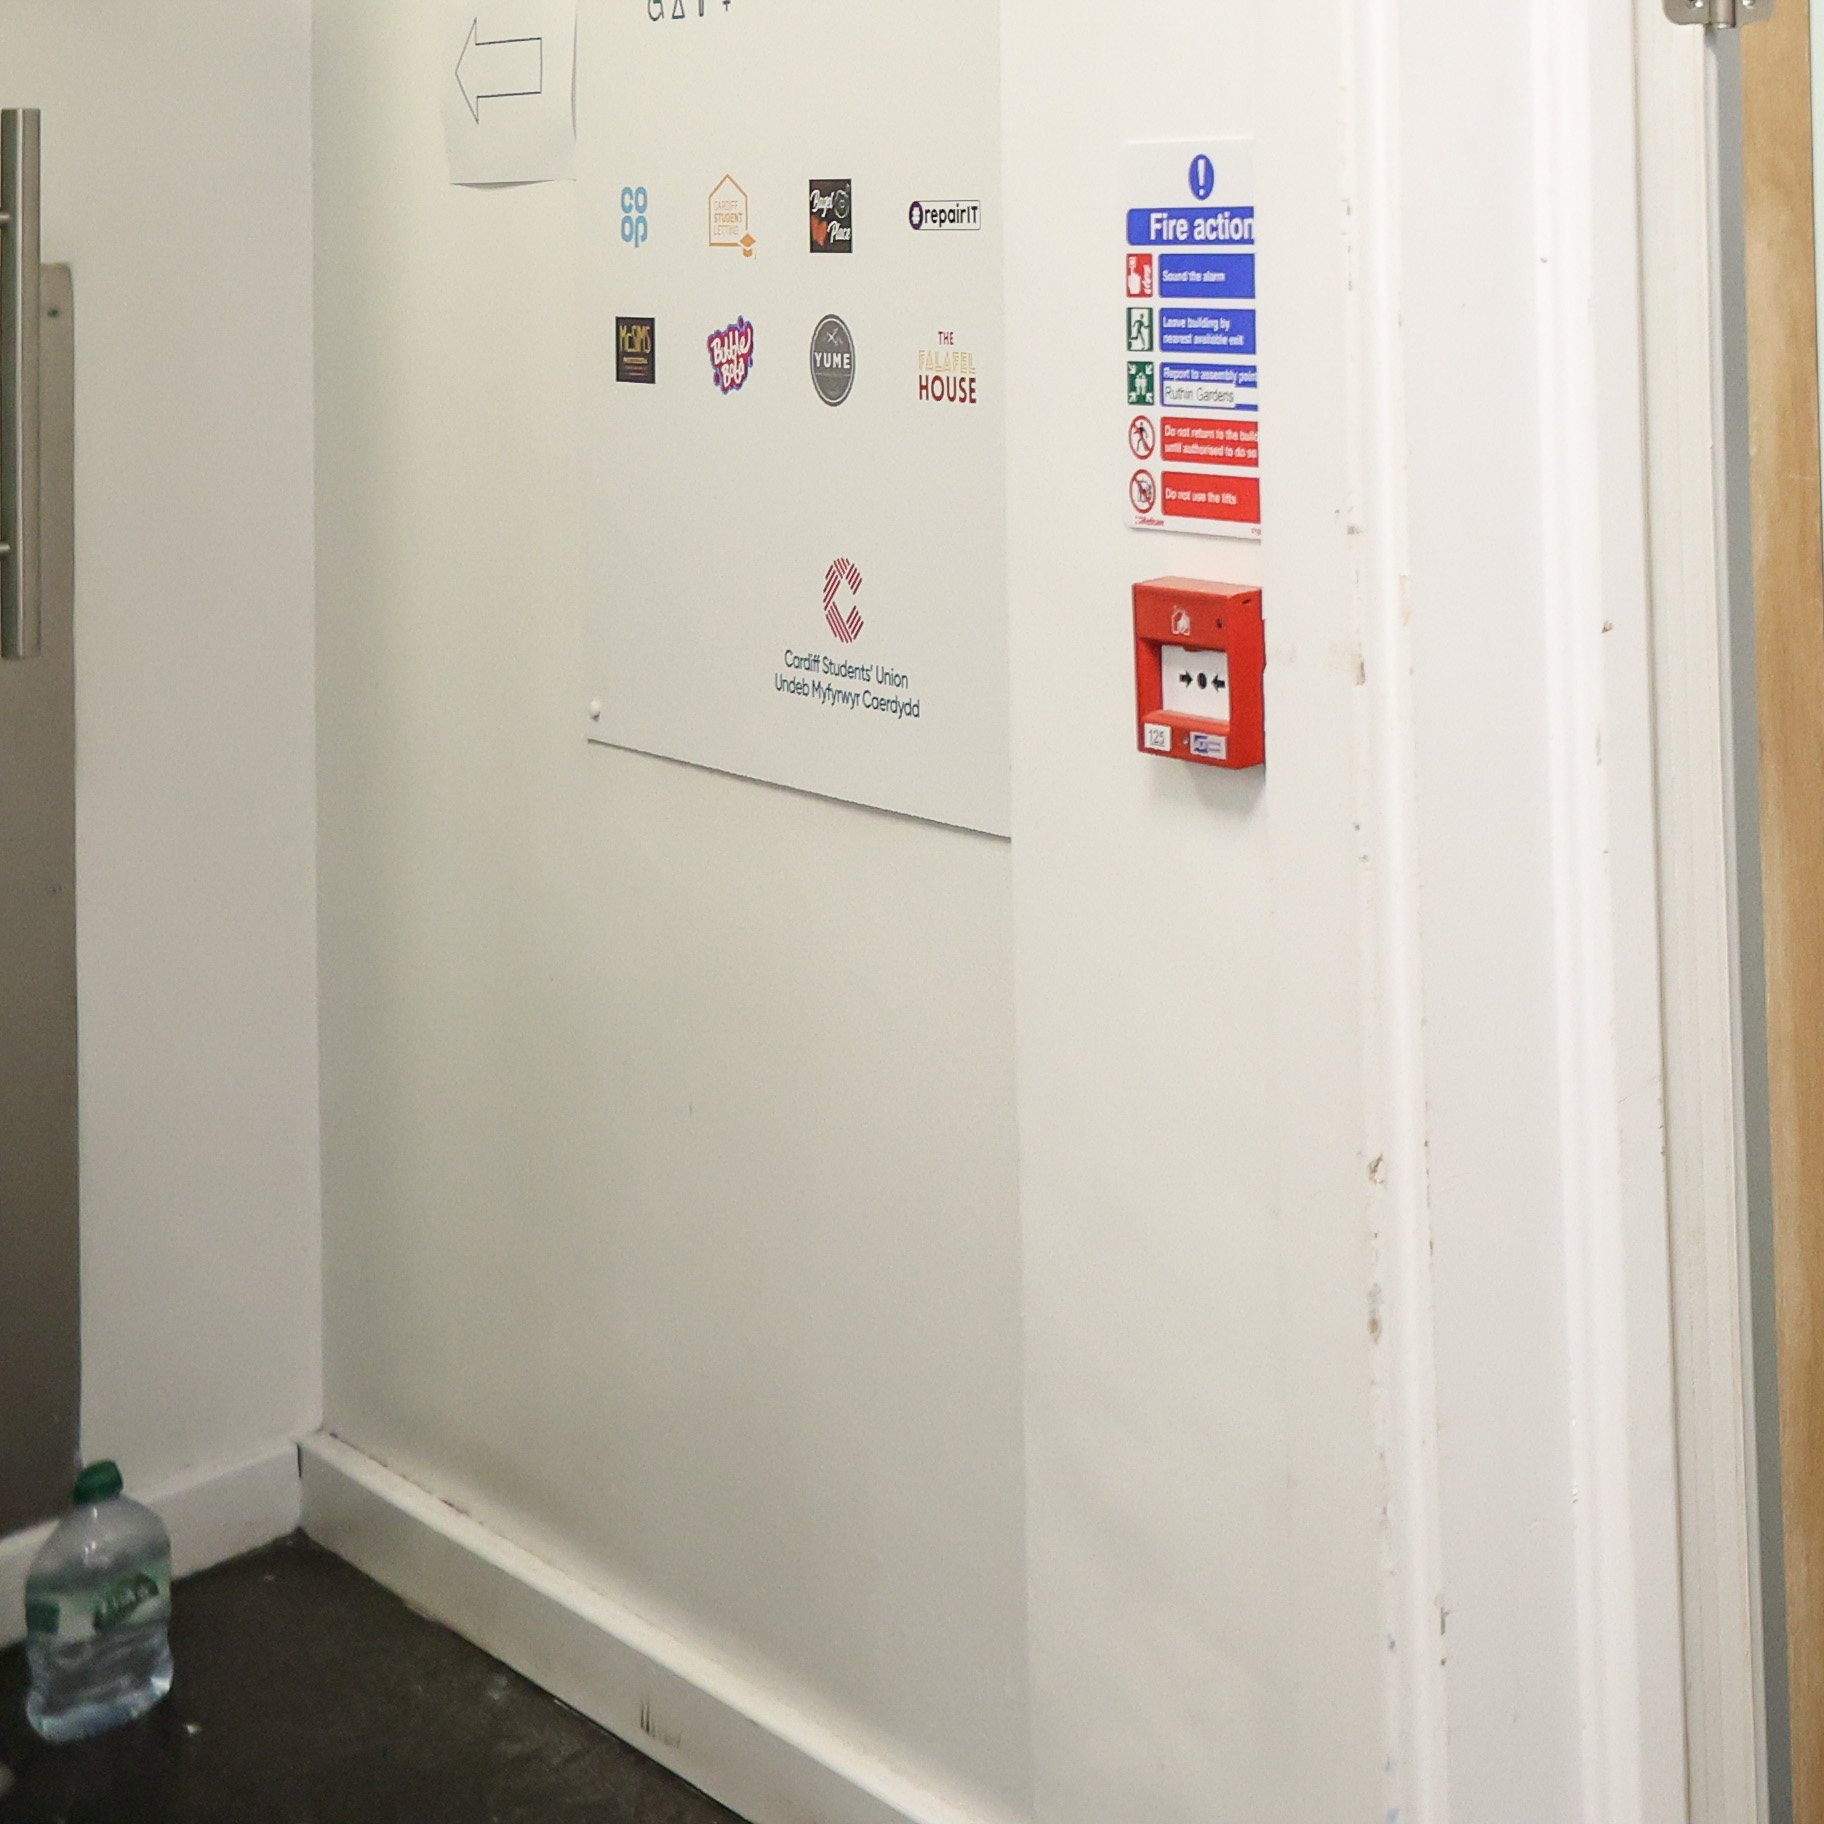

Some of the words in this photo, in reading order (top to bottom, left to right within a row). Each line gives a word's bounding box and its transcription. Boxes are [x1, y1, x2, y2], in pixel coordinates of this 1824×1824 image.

[924, 203, 978, 228] repairIT
[827, 220, 851, 244] Place
[1149, 212, 1190, 241] Fire
[1193, 211, 1254, 241] action
[1162, 270, 1188, 282] Sound
[1188, 271, 1202, 282] the
[1202, 271, 1226, 283] alarm
[1162, 316, 1187, 328] Leave
[1187, 317, 1219, 332] building
[1219, 317, 1231, 332] by
[710, 327, 751, 366] Bubble
[937, 331, 955, 346] THE
[1162, 334, 1193, 344] nearest
[1193, 334, 1228, 345] available
[1228, 335, 1244, 346] exit
[814, 352, 851, 369] YUME
[918, 349, 977, 374] FALAFEL
[721, 357, 746, 388] Boba
[1162, 366, 1190, 381] Report
[1190, 369, 1200, 380] to
[1200, 369, 1237, 385] assembly
[919, 374, 977, 405] HOUSE
[1165, 386, 1193, 401] Ruthin
[1196, 387, 1235, 403] Gardens
[1164, 424, 1176, 437] Do
[1176, 427, 1190, 437] not
[1190, 428, 1215, 440] return
[1215, 429, 1225, 441] to
[1225, 429, 1239, 442] the
[1164, 442, 1182, 454] until
[1224, 446, 1234, 458] to
[1234, 447, 1246, 459] do
[1246, 448, 1258, 459] so
[1165, 488, 1177, 500] Do
[1177, 490, 1191, 501] not
[1191, 491, 1206, 502] use
[1206, 492, 1221, 504] the
[1221, 492, 1237, 505] lifts
[784, 649, 821, 673] Cardiff
[822, 655, 874, 683] Students'
[876, 665, 909, 690] Union
[775, 673, 810, 697] Undeb
[811, 679, 861, 711] Myfyrwyr
[862, 690, 921, 720] Caerdydd
